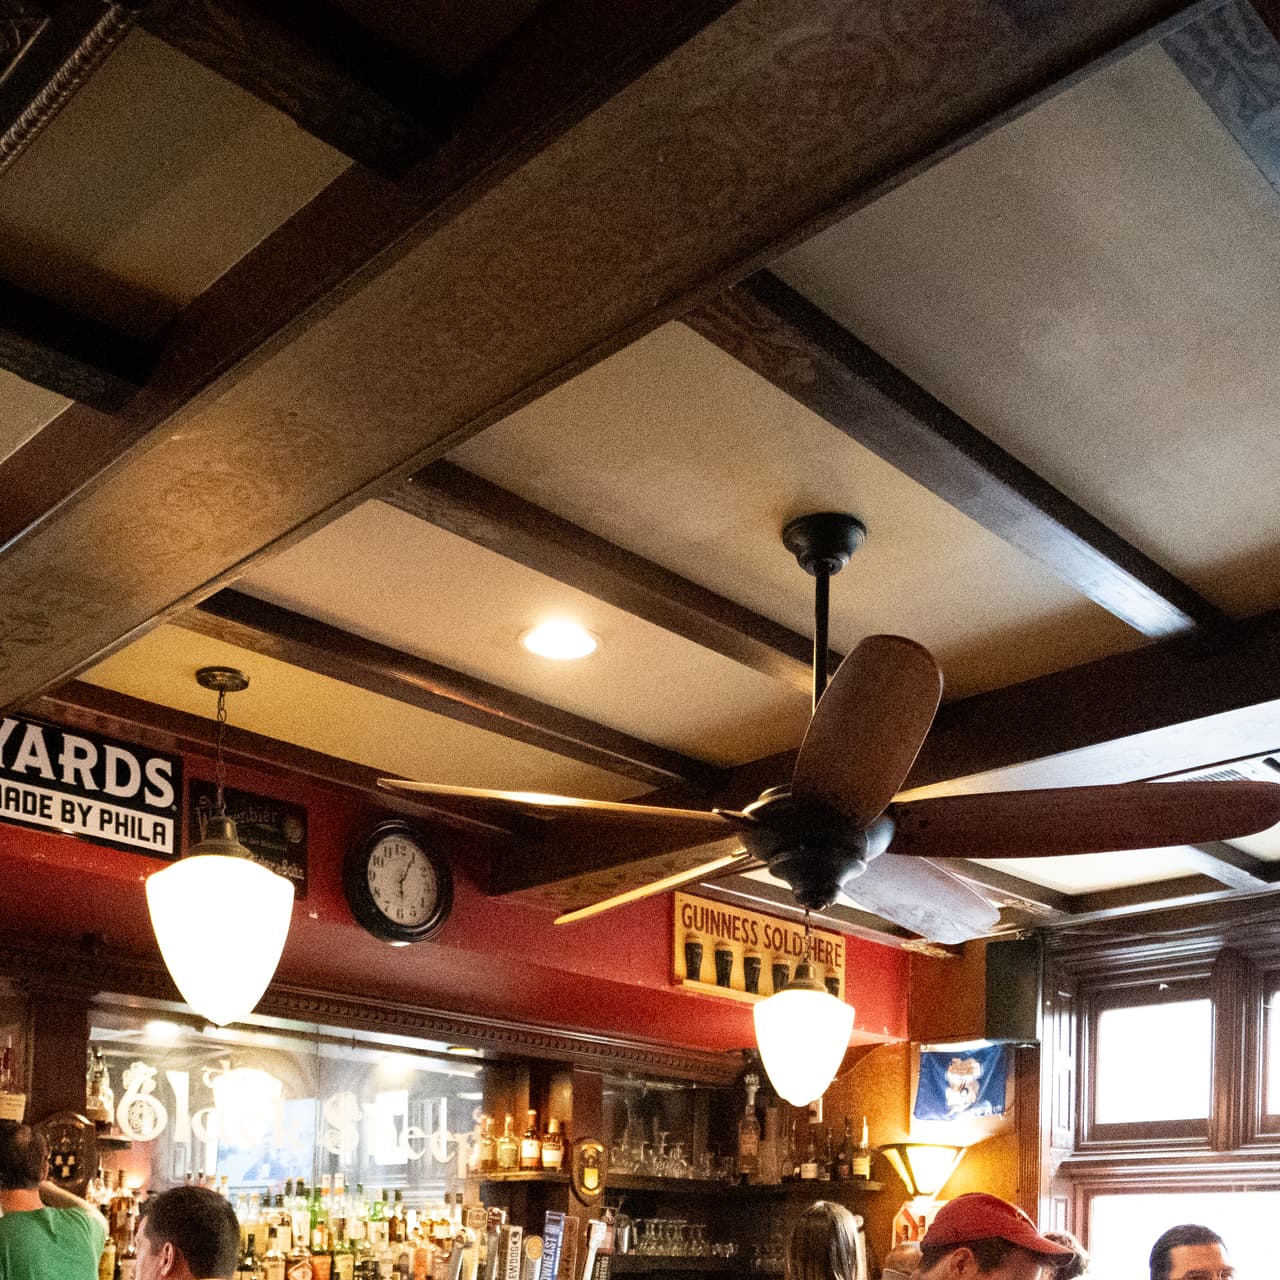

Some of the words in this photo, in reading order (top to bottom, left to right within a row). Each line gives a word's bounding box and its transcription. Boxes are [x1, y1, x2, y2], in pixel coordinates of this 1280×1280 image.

[61, 799, 93, 828] BY
[99, 808, 166, 846] PHILA
[682, 903, 759, 946] GUINNESS
[764, 924, 803, 957] SOLD
[809, 935, 842, 968] HERE
